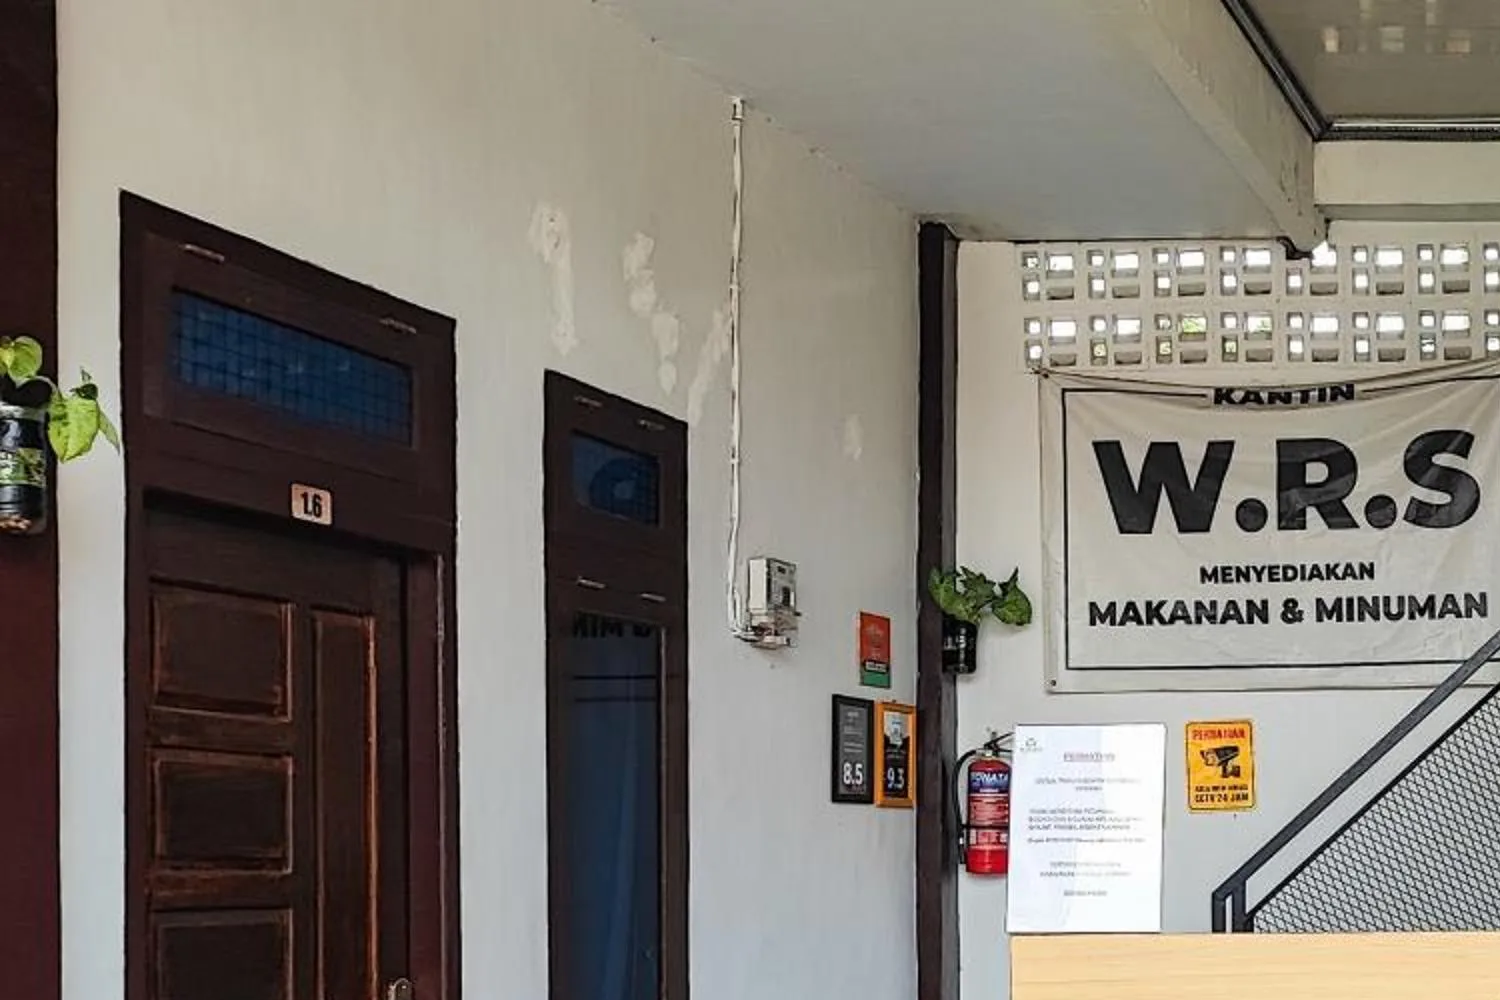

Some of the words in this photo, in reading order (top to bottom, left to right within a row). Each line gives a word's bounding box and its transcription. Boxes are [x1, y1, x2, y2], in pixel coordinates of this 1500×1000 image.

[1213, 384, 1355, 405] KANTIN
[1092, 429, 1481, 535] W.R.S
[300, 491, 322, 518] 16
[1199, 562, 1375, 585] MENYEDIAKAN
[1088, 597, 1269, 627] MAKANAN
[1280, 597, 1304, 624] &
[1315, 592, 1488, 622] MINUMAN
